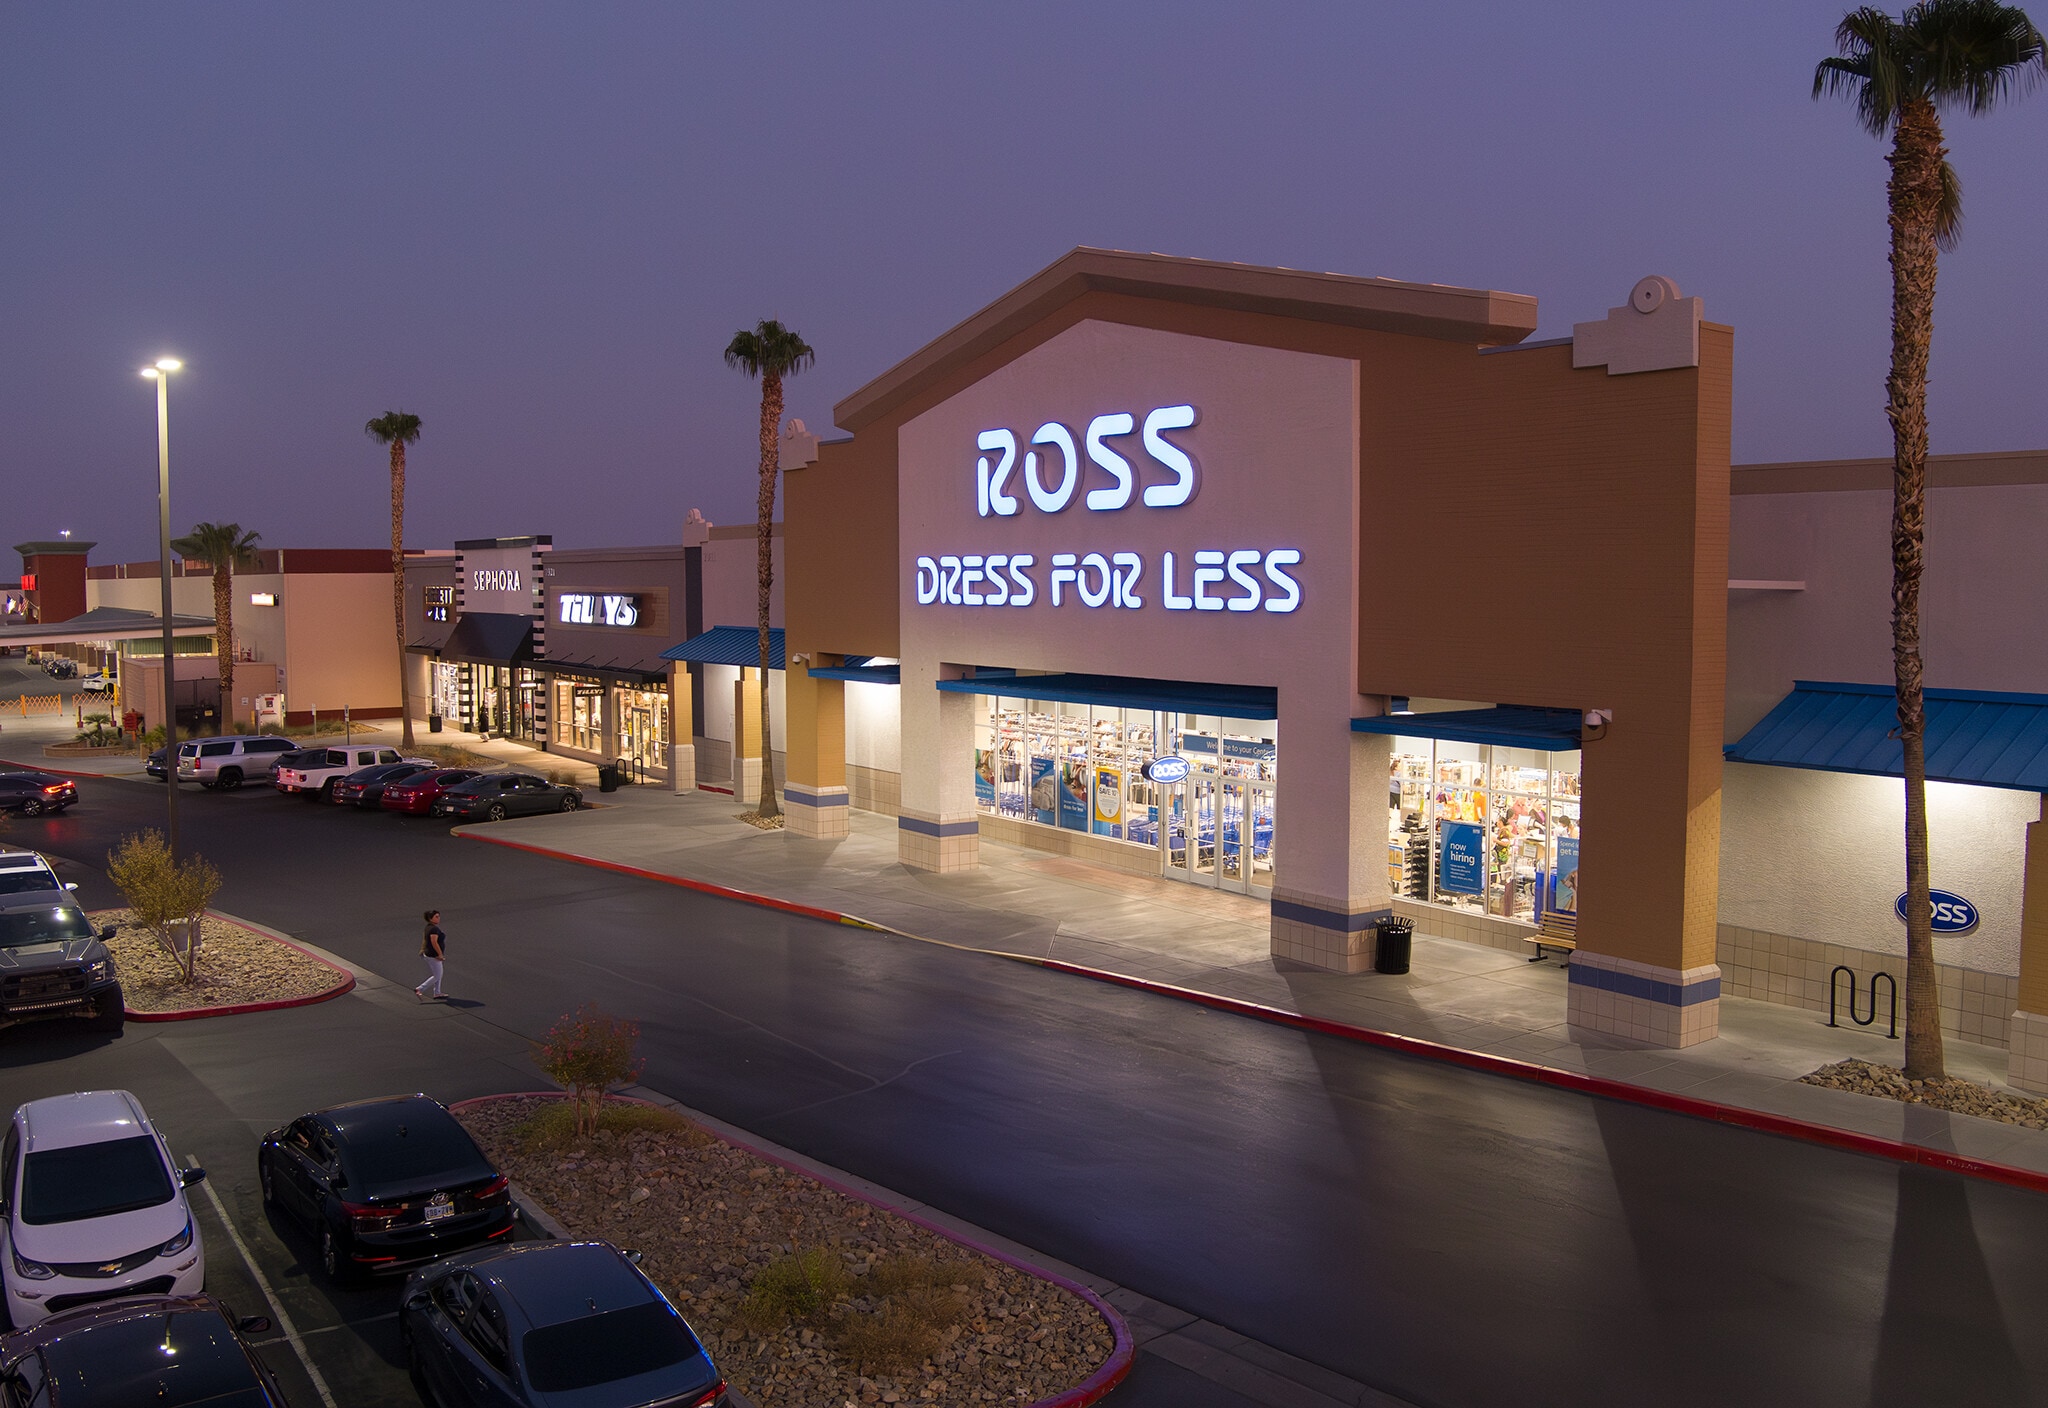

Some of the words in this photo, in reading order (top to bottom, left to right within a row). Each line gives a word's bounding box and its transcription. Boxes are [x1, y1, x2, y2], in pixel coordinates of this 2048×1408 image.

[977, 404, 1196, 517] ROSS
[473, 570, 521, 591] SEPHORA
[917, 554, 1035, 606] DRESS
[1051, 552, 1143, 609] FOR
[1163, 549, 1301, 612] LESS
[1206, 741, 1231, 752] Welme
[1232, 744, 1238, 752] to
[1239, 746, 1252, 754] your
[1154, 762, 1186, 778] ROSS
[1099, 787, 1111, 796] SAVE
[1450, 843, 1467, 851] now
[1559, 841, 1575, 849] Spend
[1560, 848, 1572, 856] get
[1450, 851, 1475, 866] hiring
[1905, 900, 1968, 924] OSS
